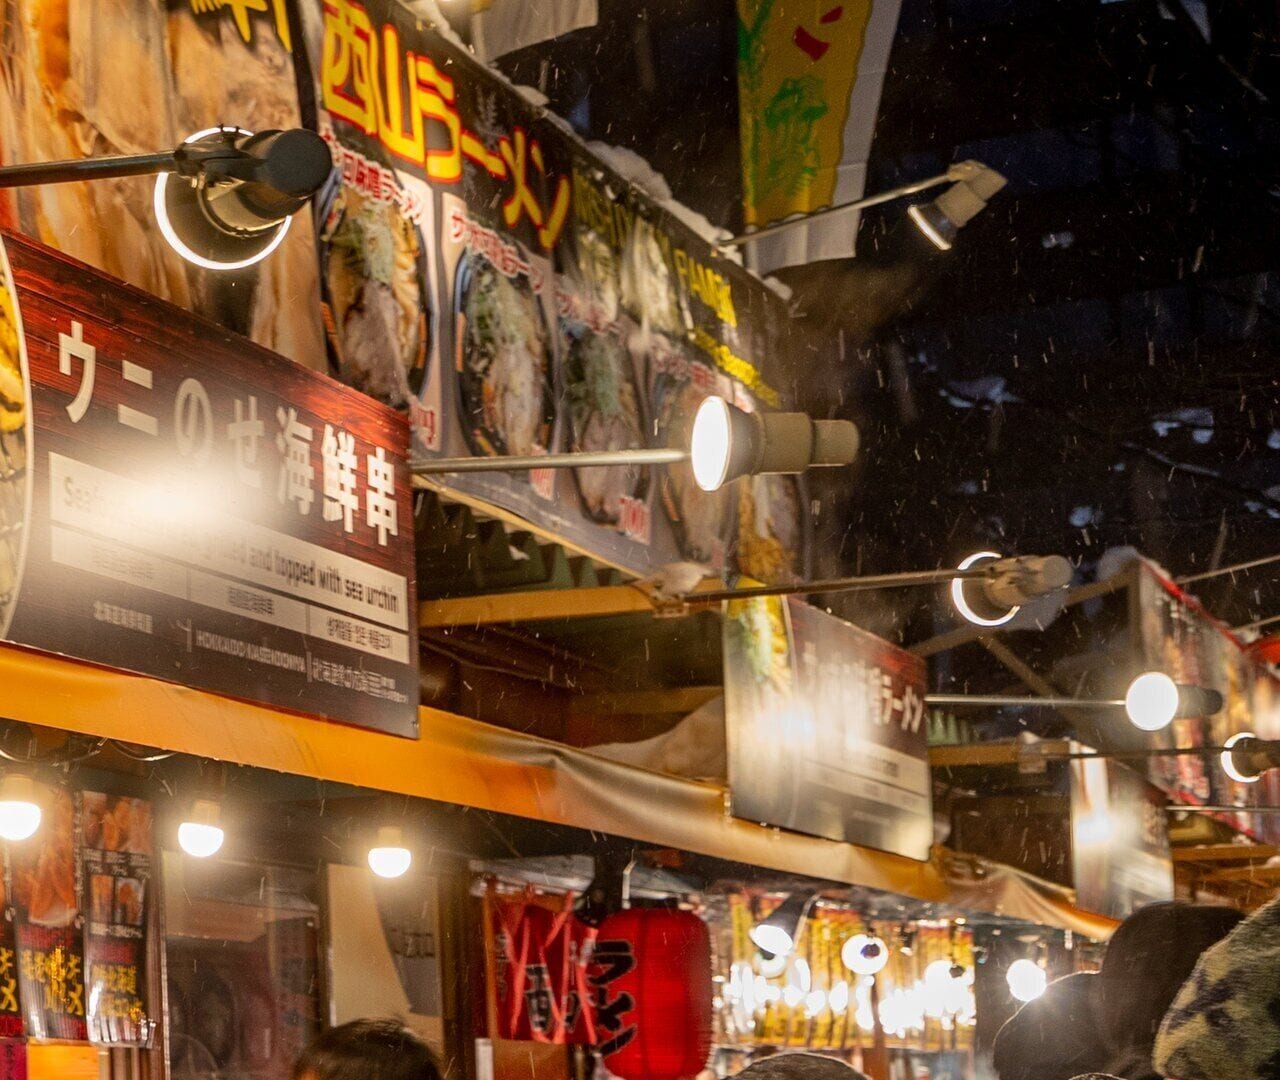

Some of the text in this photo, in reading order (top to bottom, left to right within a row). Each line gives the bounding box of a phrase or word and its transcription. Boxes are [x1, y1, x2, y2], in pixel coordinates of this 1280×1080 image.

[321, 0, 571, 251] 西山ラーメン
[275, 550, 316, 588] topped
[318, 564, 343, 596] with
[345, 578, 364, 602] sea
[366, 585, 400, 614] urchin
